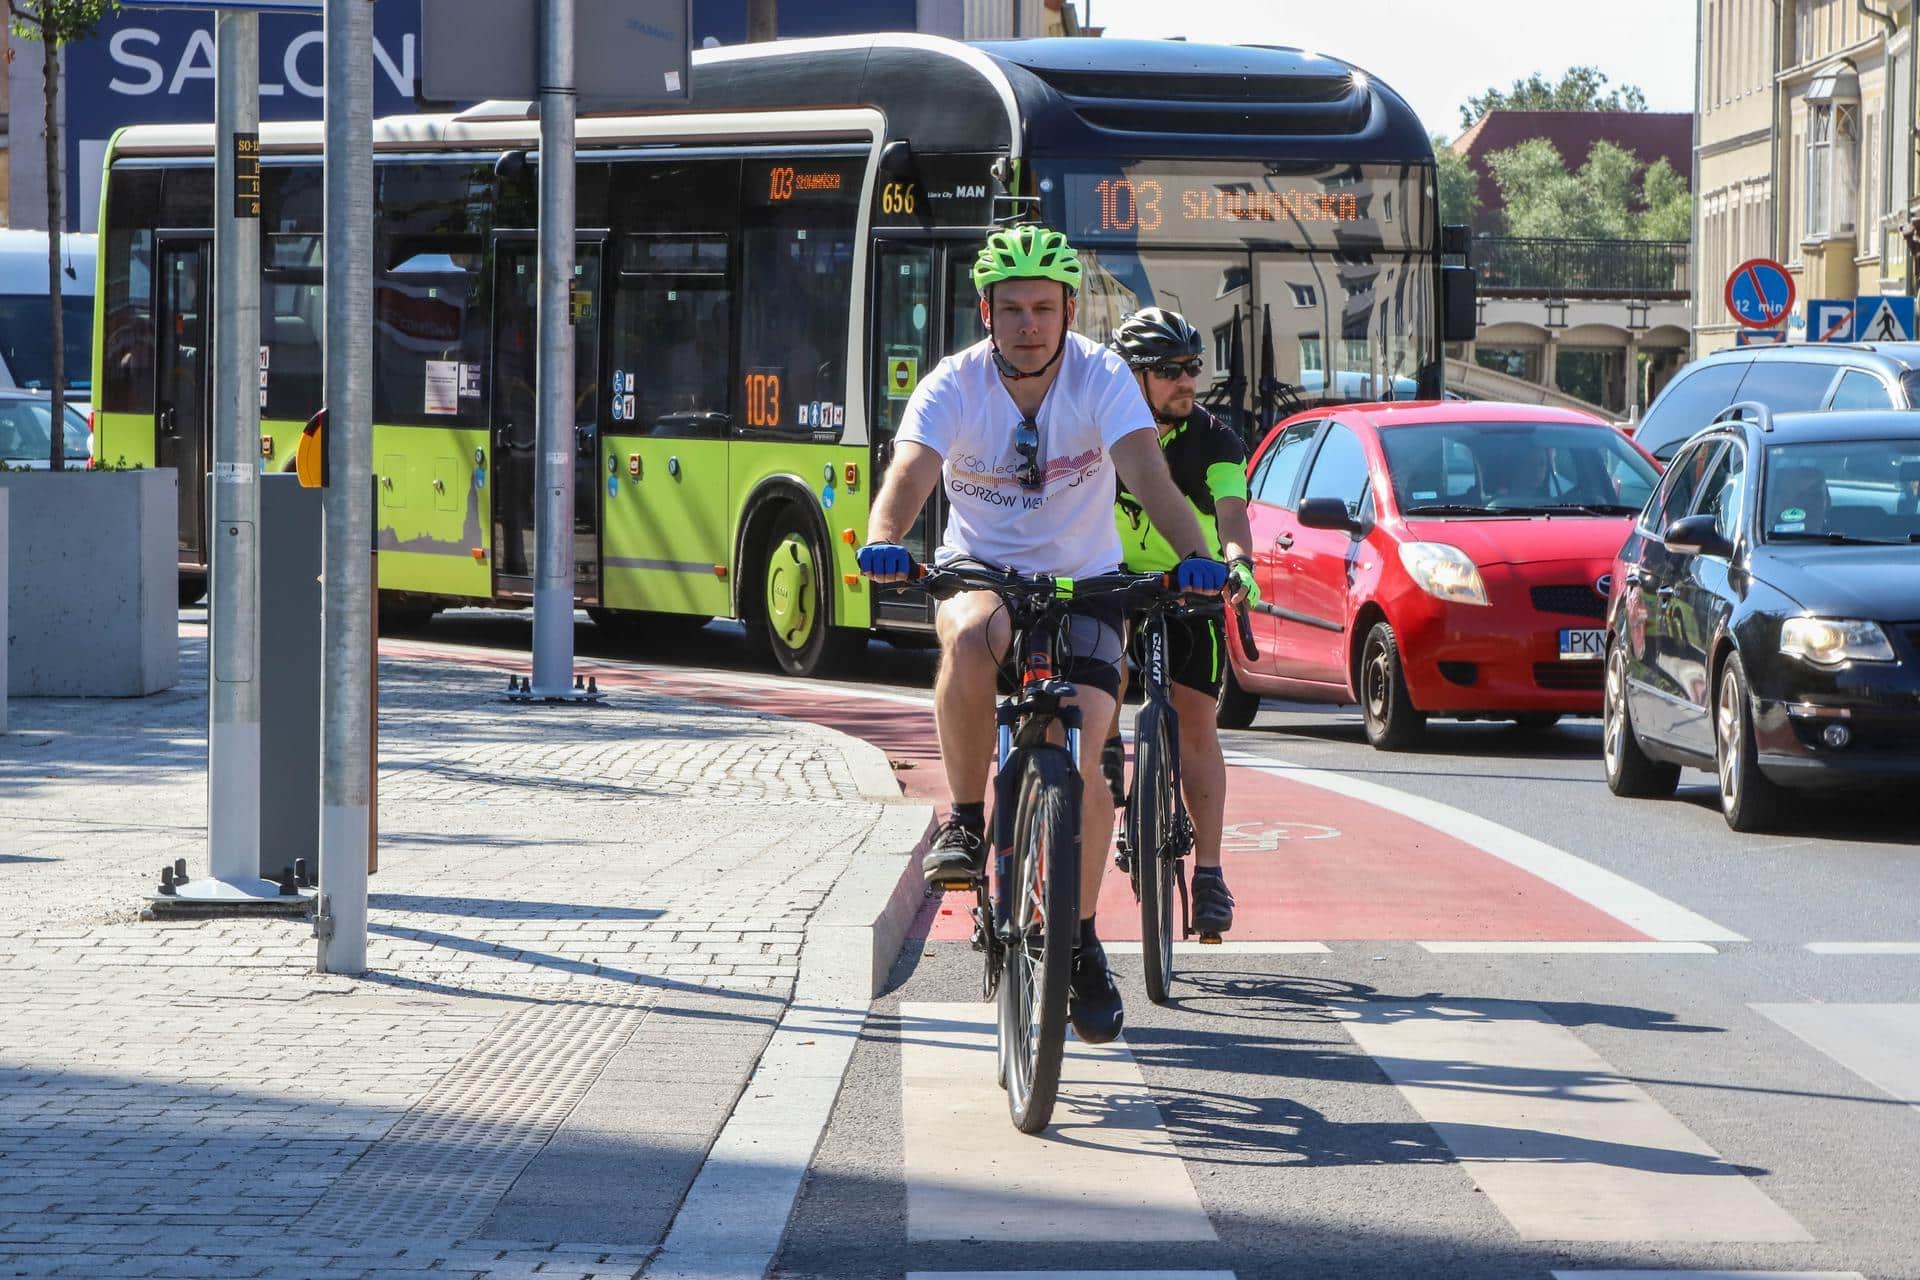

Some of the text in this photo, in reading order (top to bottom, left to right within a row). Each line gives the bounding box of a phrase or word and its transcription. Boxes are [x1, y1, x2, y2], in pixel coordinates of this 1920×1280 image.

[108, 26, 415, 98] SAON
[769, 167, 794, 200] 103
[882, 182, 915, 215] 656
[956, 185, 985, 198] MAN
[1095, 178, 1163, 230] 103
[1736, 299, 1784, 313] 12 min
[745, 374, 780, 427] 103
[951, 479, 1017, 509] GORZÓW
[1570, 631, 1607, 652] PKN
